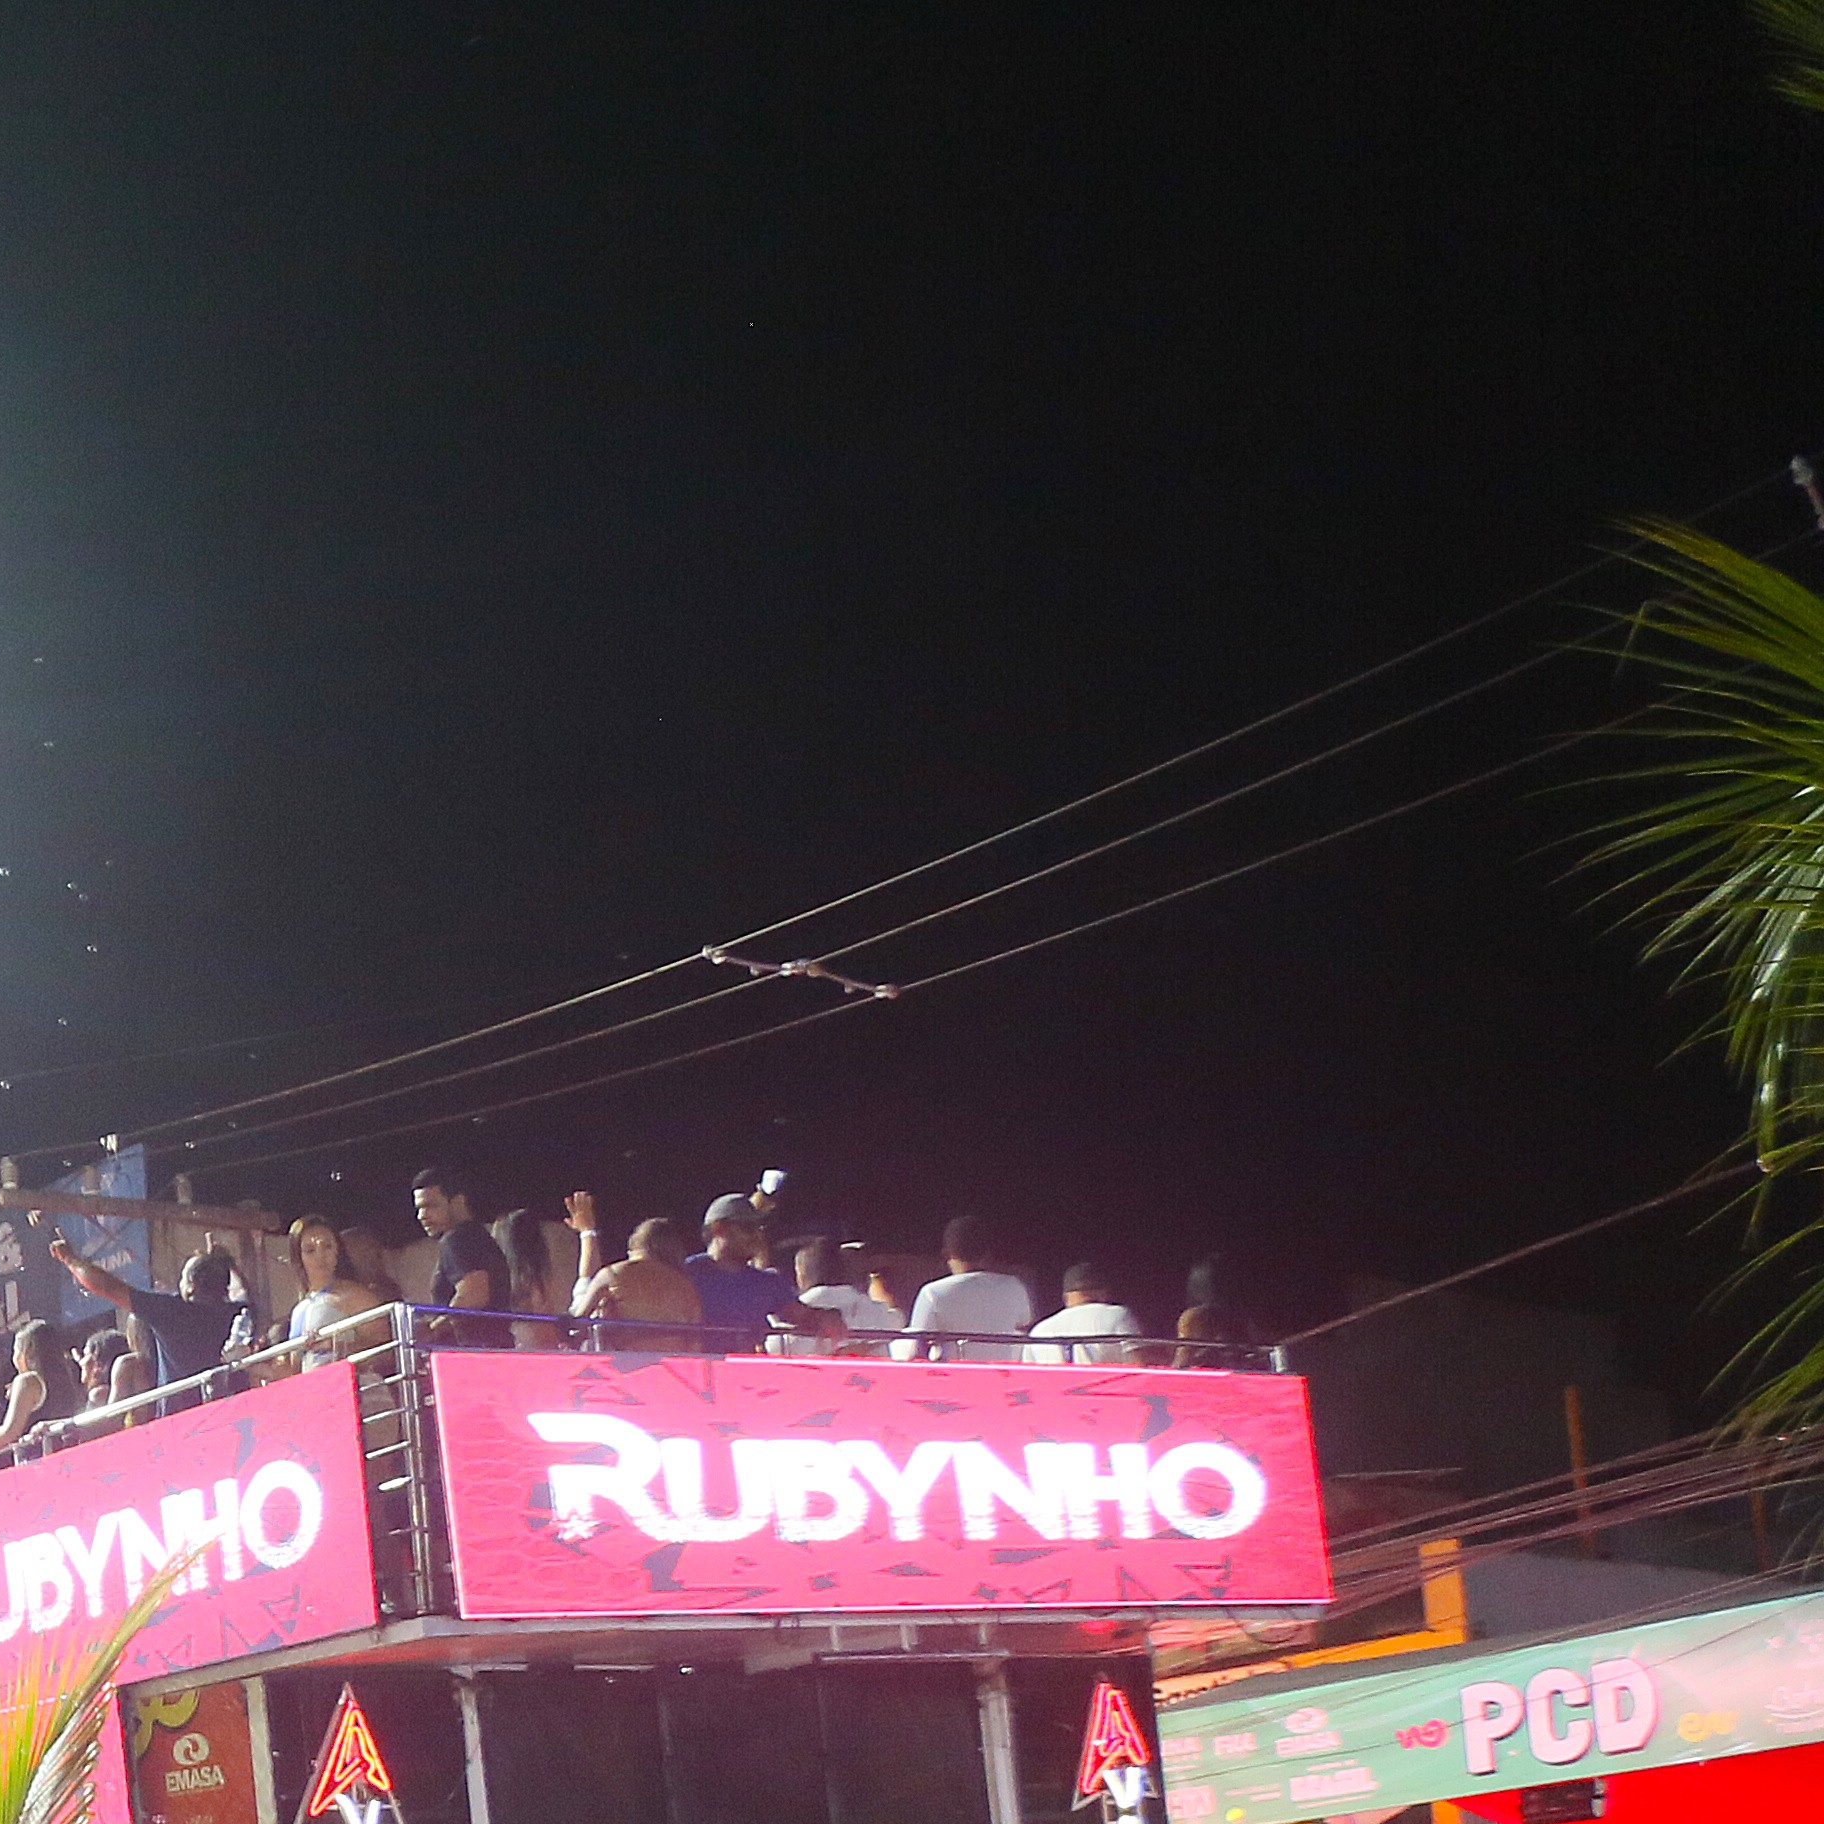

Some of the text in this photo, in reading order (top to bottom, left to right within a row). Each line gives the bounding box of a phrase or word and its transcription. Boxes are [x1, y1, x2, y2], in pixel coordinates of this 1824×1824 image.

[528, 1412, 1267, 1545] RUBYNHO
[1460, 1657, 1660, 1775] PCD
[165, 1764, 226, 1794] EMASA
